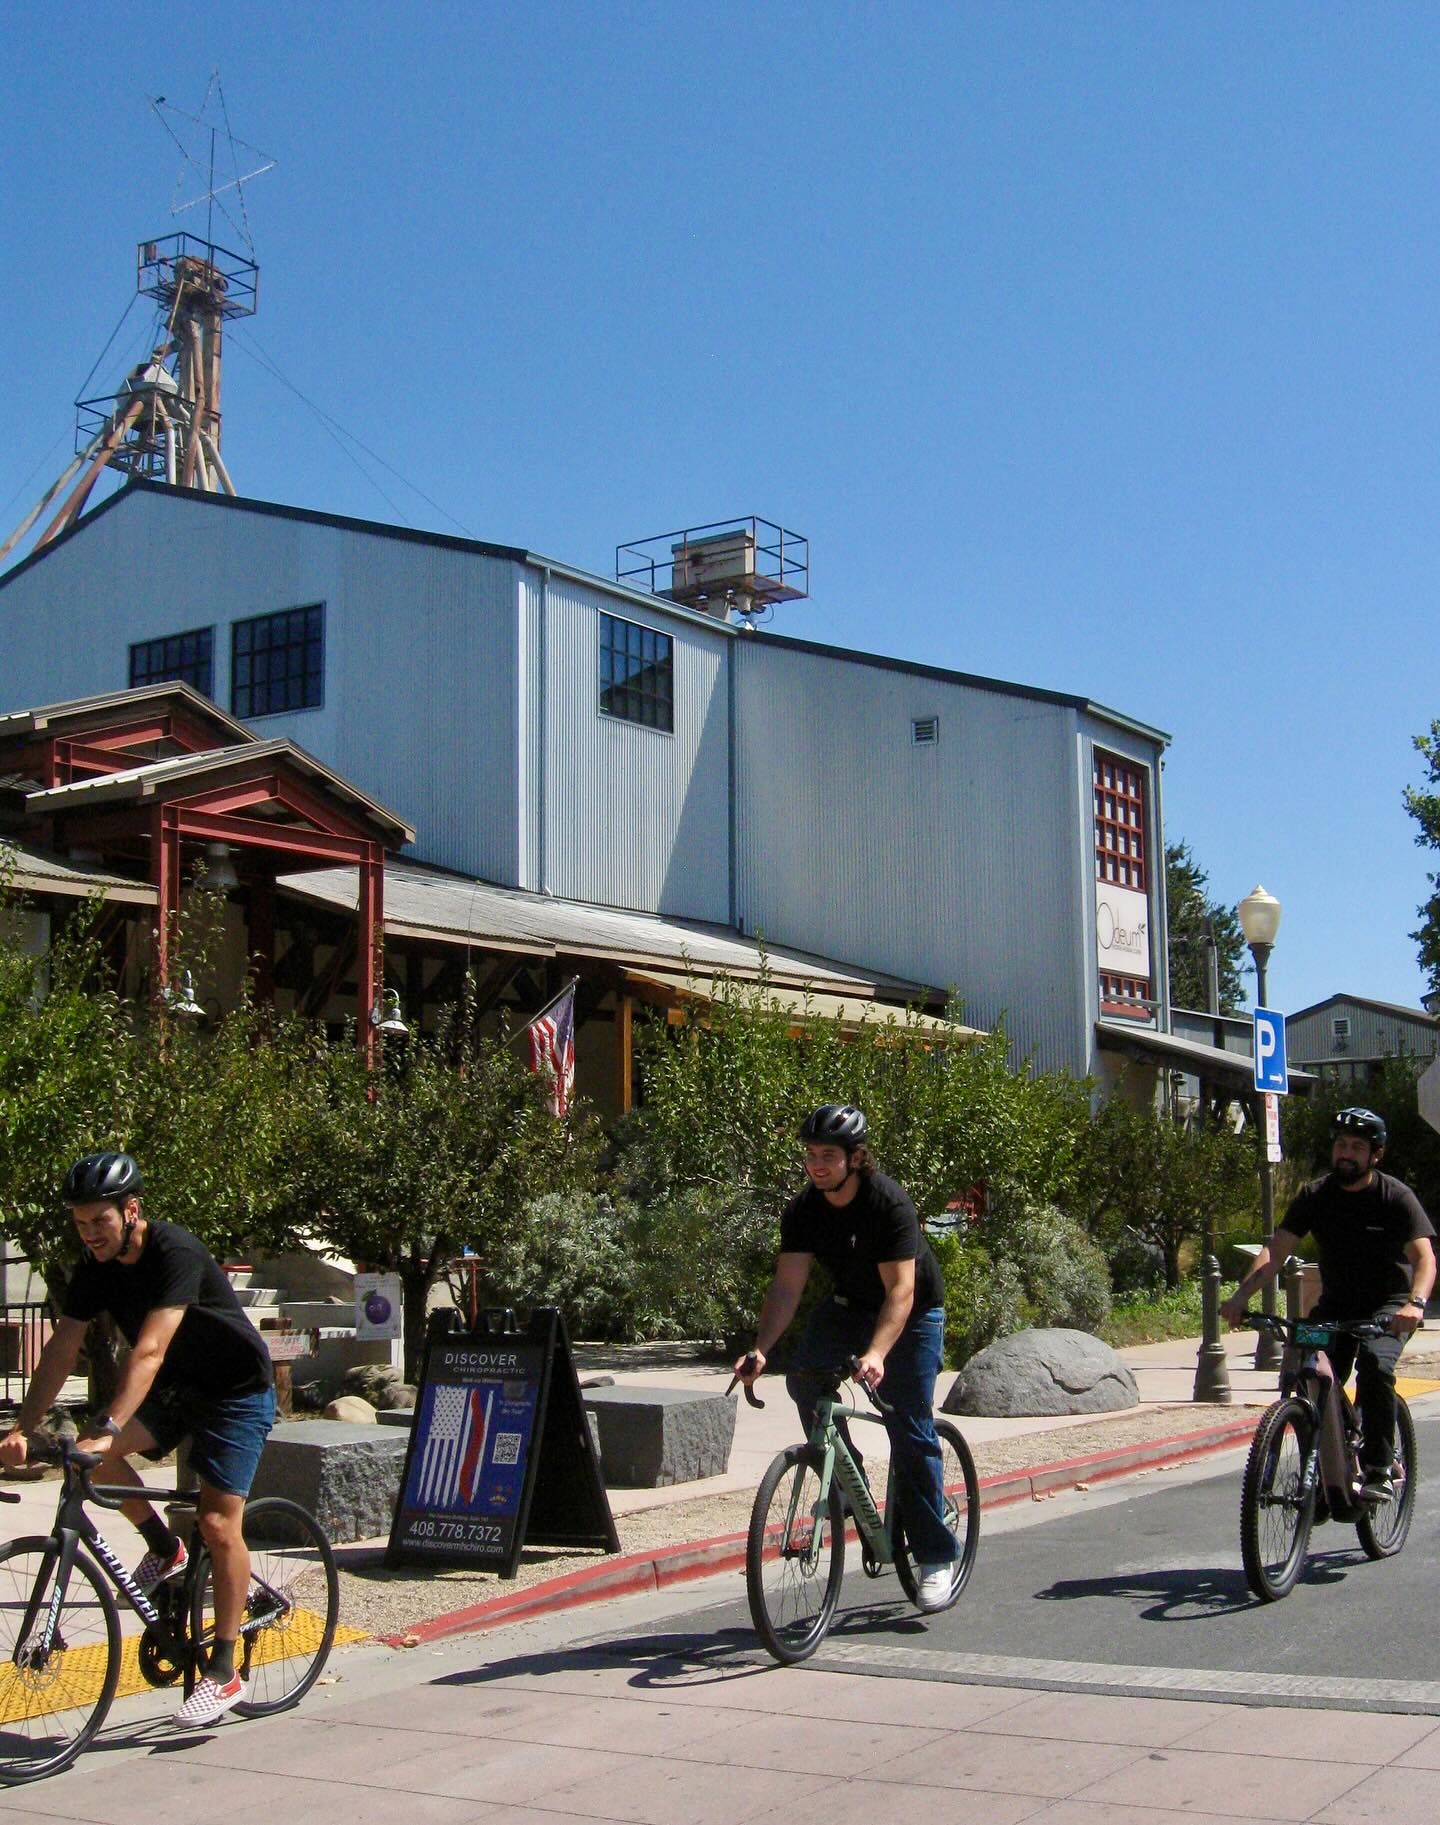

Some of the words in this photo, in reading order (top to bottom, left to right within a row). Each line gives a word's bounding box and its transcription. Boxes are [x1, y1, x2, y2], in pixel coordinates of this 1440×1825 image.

[1097, 902, 1143, 950] Odeum
[1256, 1019, 1276, 1080] P
[444, 1353, 517, 1366] DISCOVER
[452, 1366, 526, 1375] CHIROPRACTIC
[409, 1520, 502, 1542] 408.778.7372
[402, 1537, 504, 1553] www.discovermhchiro.com
[89, 1533, 160, 1622] SPECIALIZED
